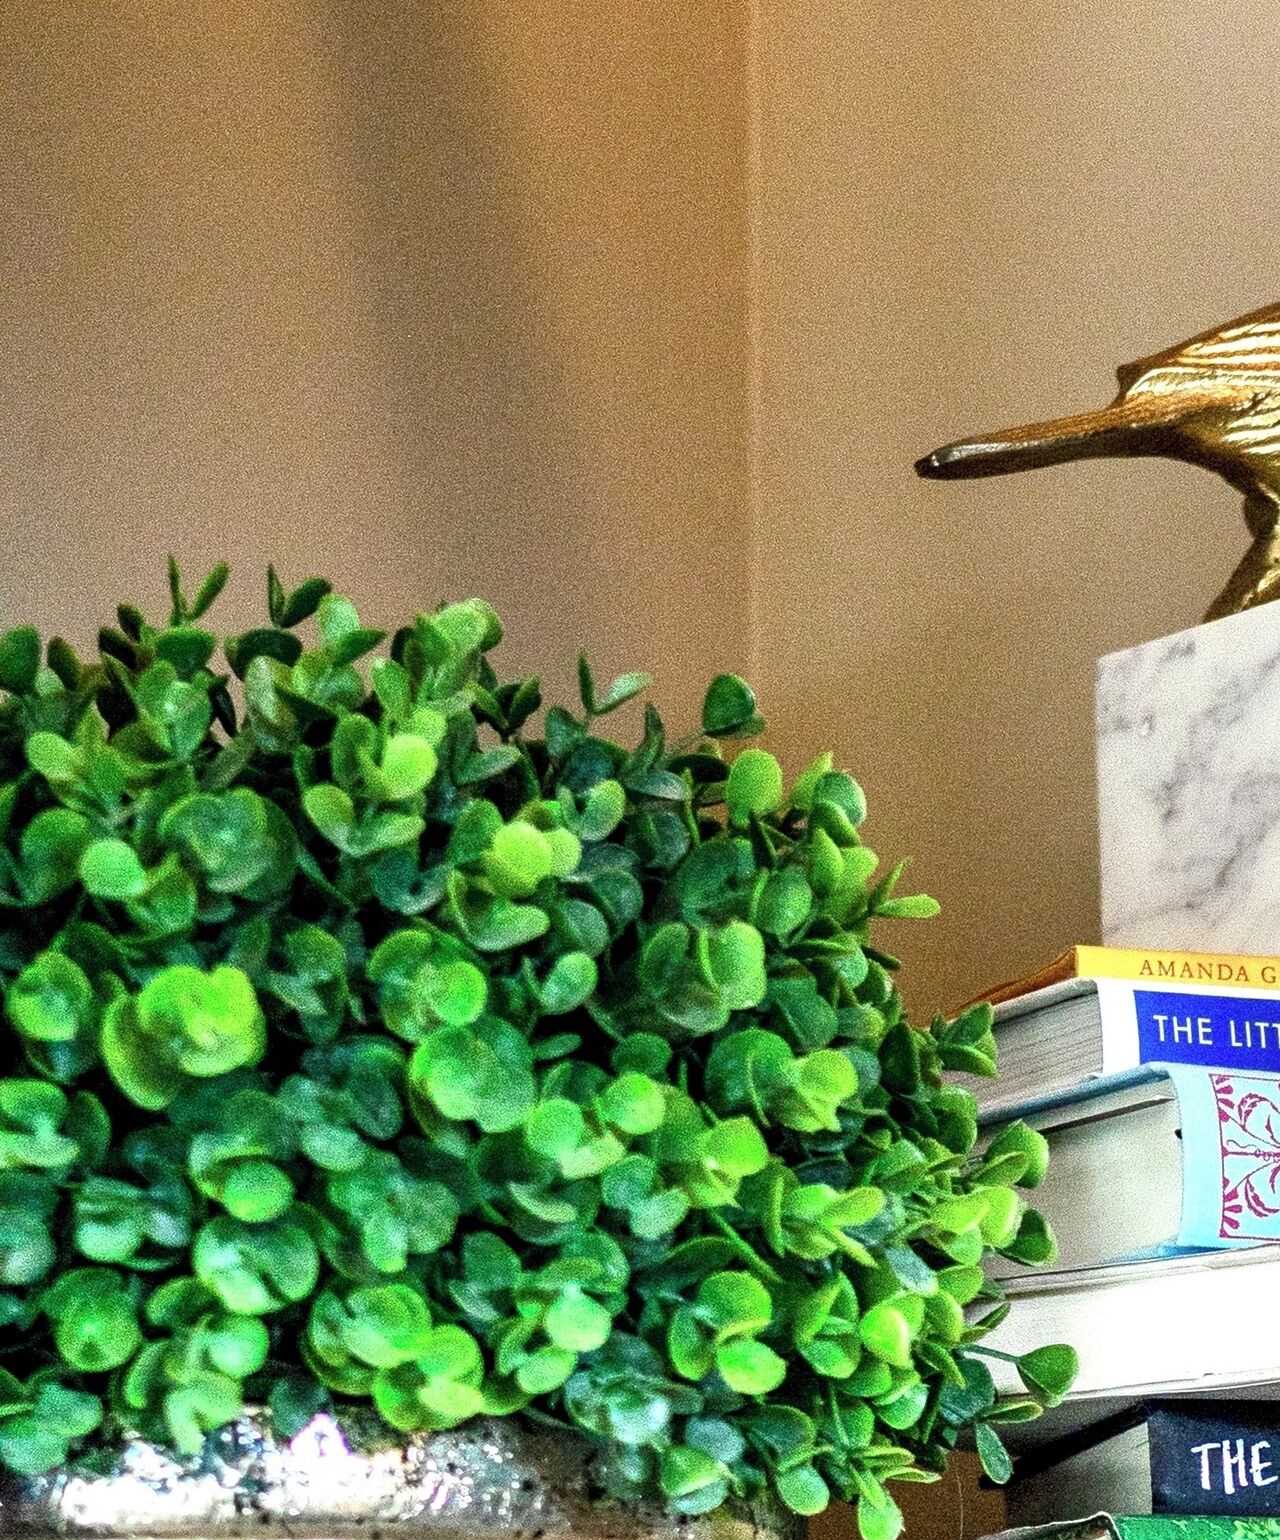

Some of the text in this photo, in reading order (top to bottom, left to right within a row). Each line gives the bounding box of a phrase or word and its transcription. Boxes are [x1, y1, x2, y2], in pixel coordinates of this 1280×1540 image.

[1139, 959, 1250, 982] AMANDA
[1153, 1014, 1213, 1046] THE
[1190, 1438, 1278, 1494] THE
